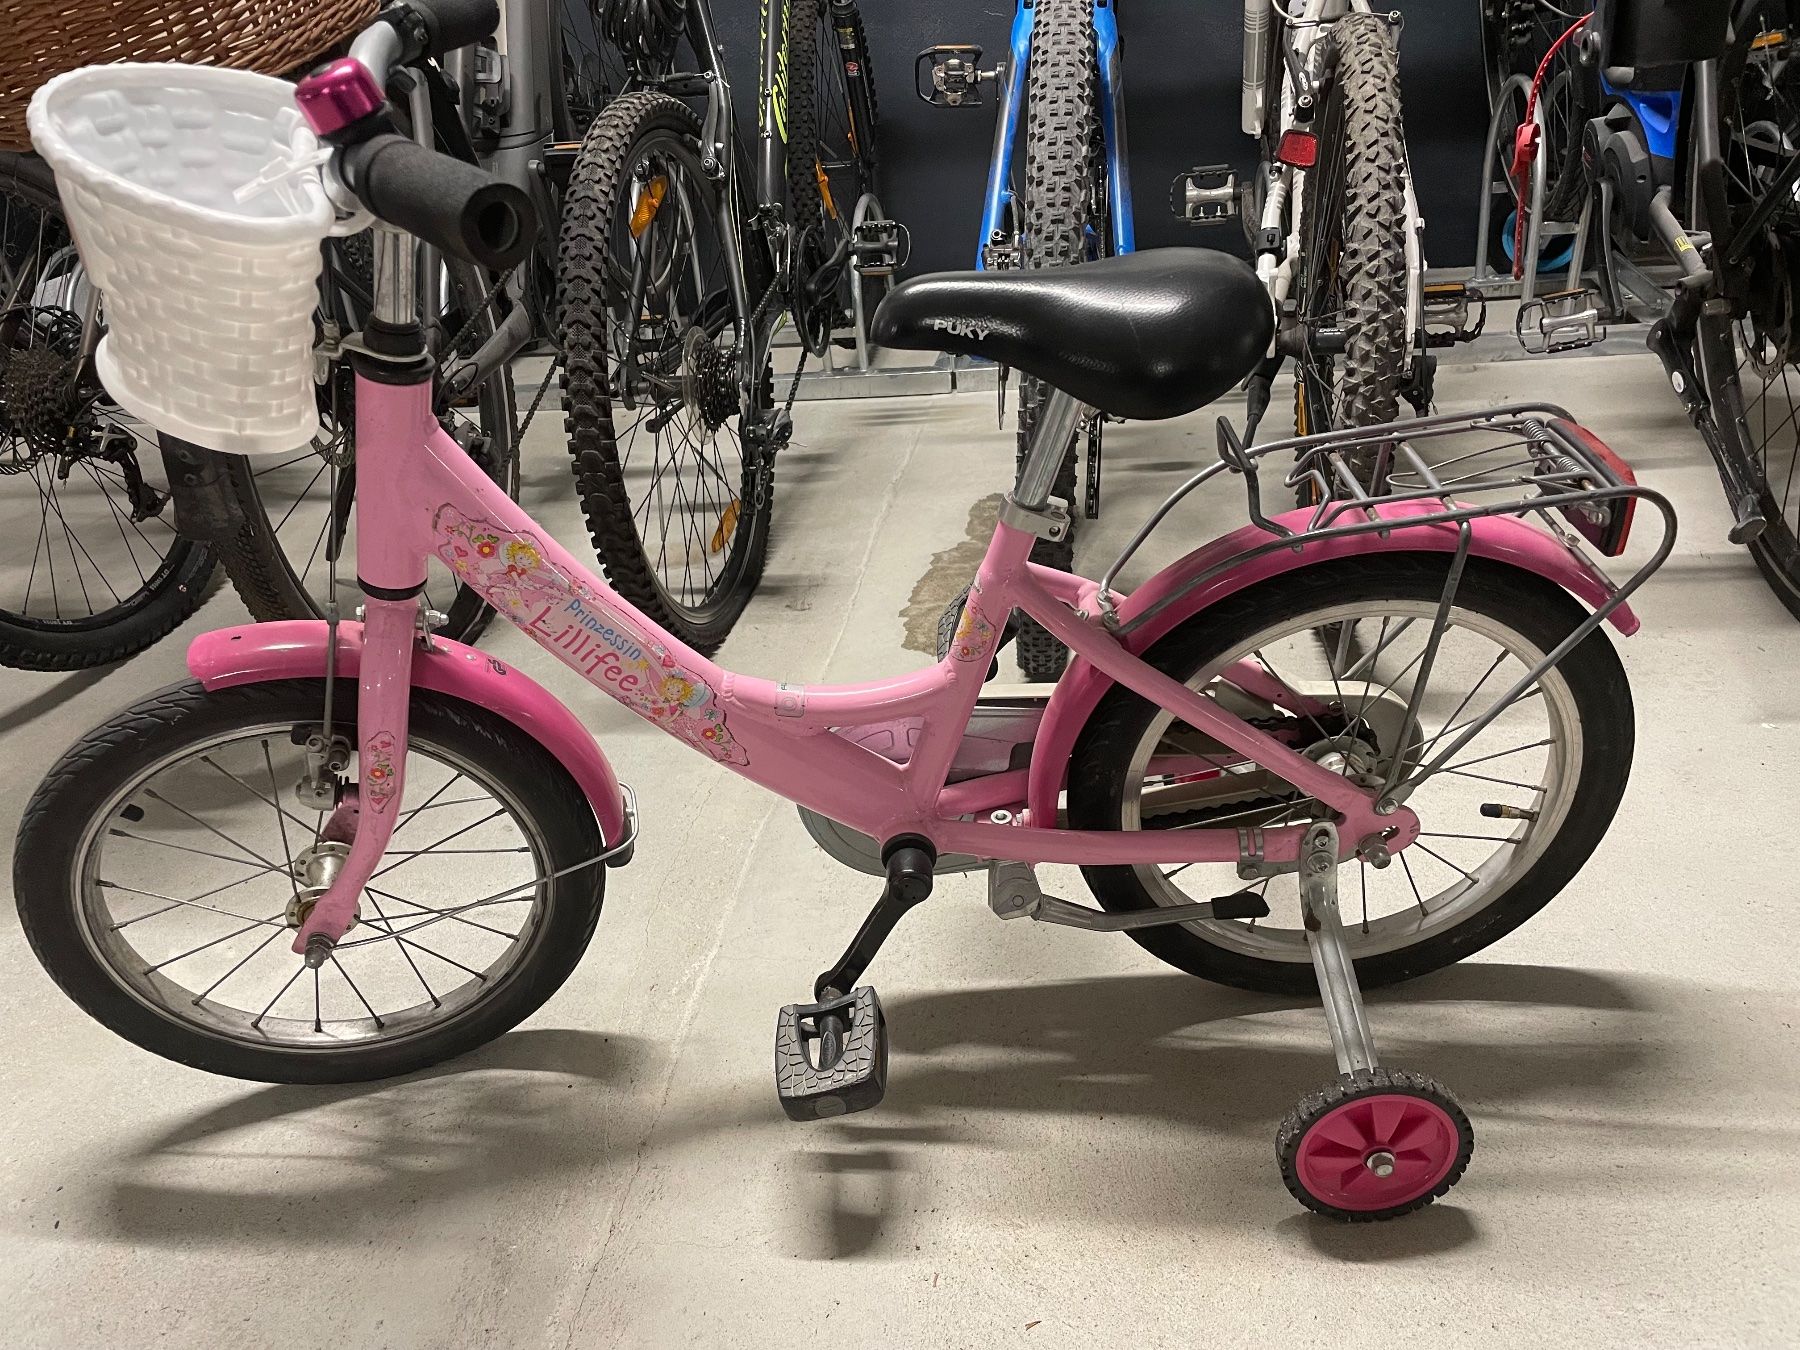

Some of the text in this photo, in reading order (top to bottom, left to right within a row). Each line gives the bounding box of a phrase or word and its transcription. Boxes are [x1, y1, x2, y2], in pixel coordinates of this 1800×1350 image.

[933, 318, 990, 341] PUKY
[528, 606, 640, 693] Lillifee
[564, 599, 642, 661] Prinzessin
